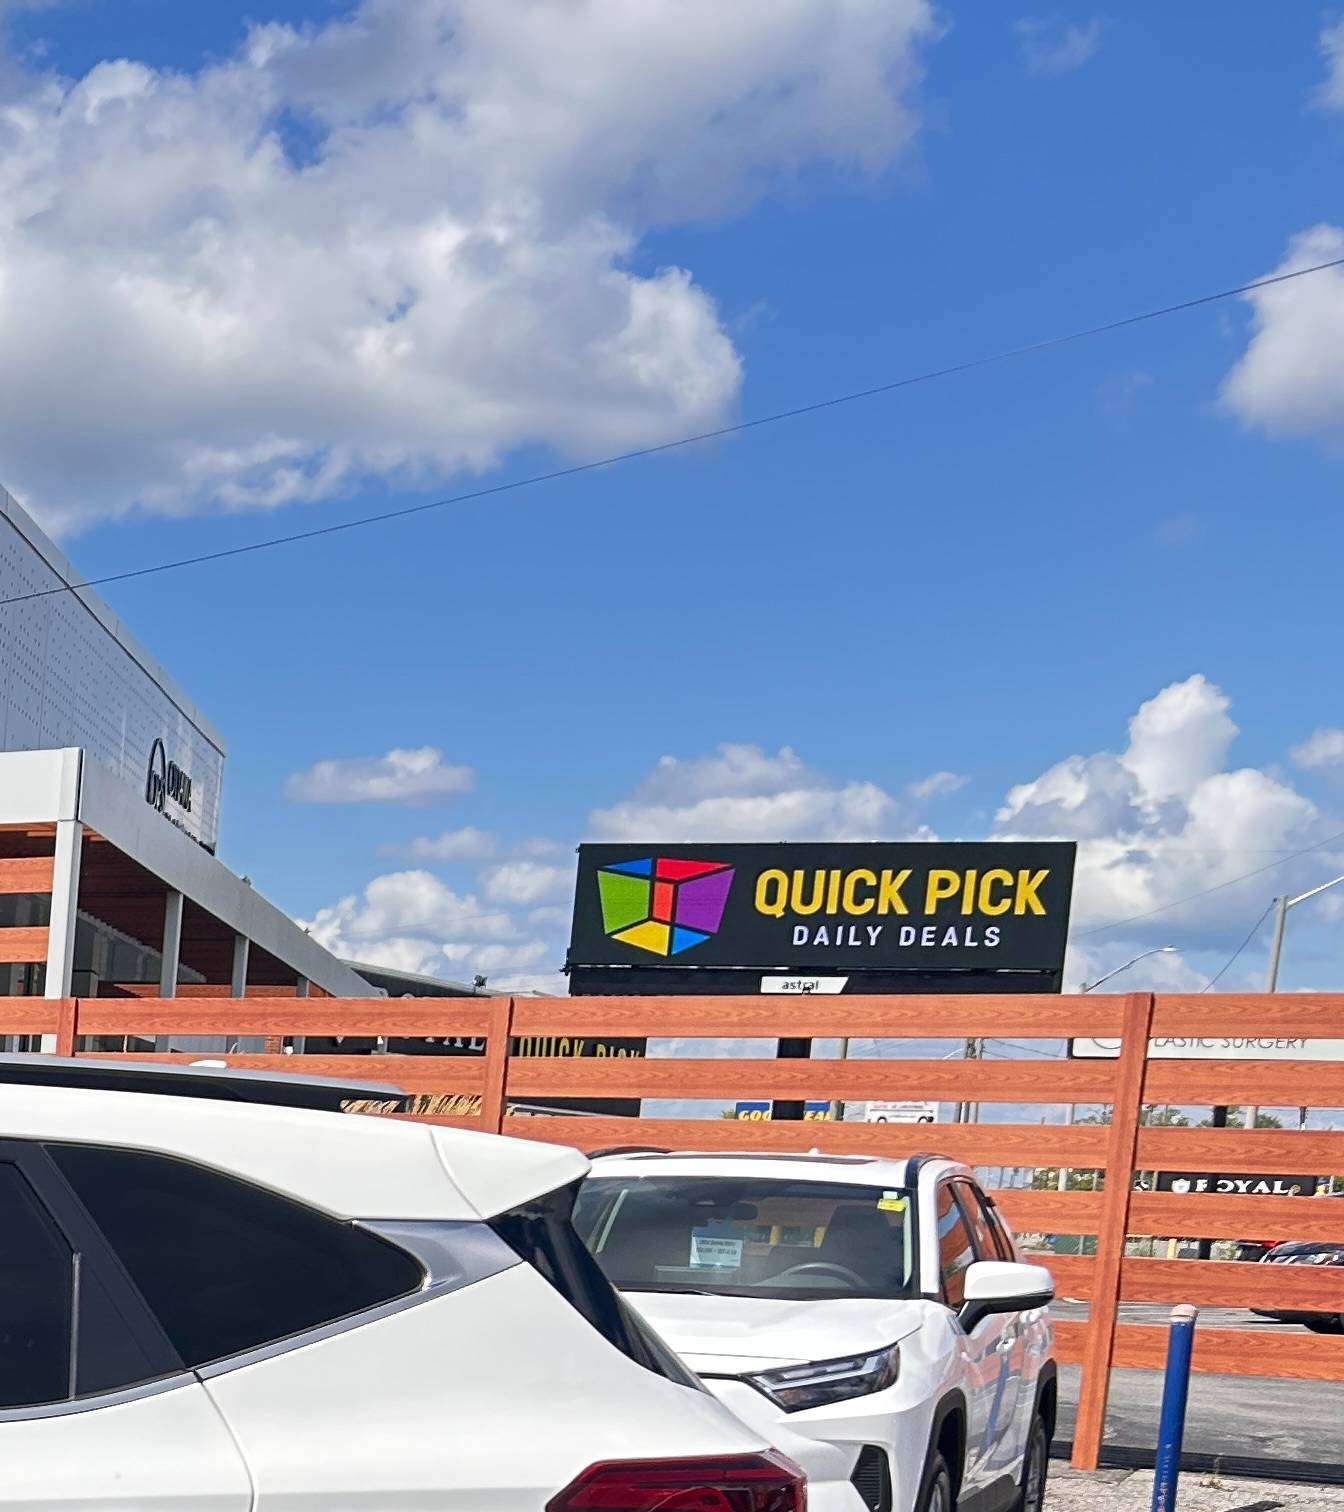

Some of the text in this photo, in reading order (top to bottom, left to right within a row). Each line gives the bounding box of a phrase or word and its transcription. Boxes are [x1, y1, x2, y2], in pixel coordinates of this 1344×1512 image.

[754, 867, 1050, 918] QUICK PICK
[792, 924, 1001, 947] DAILY DEALS
